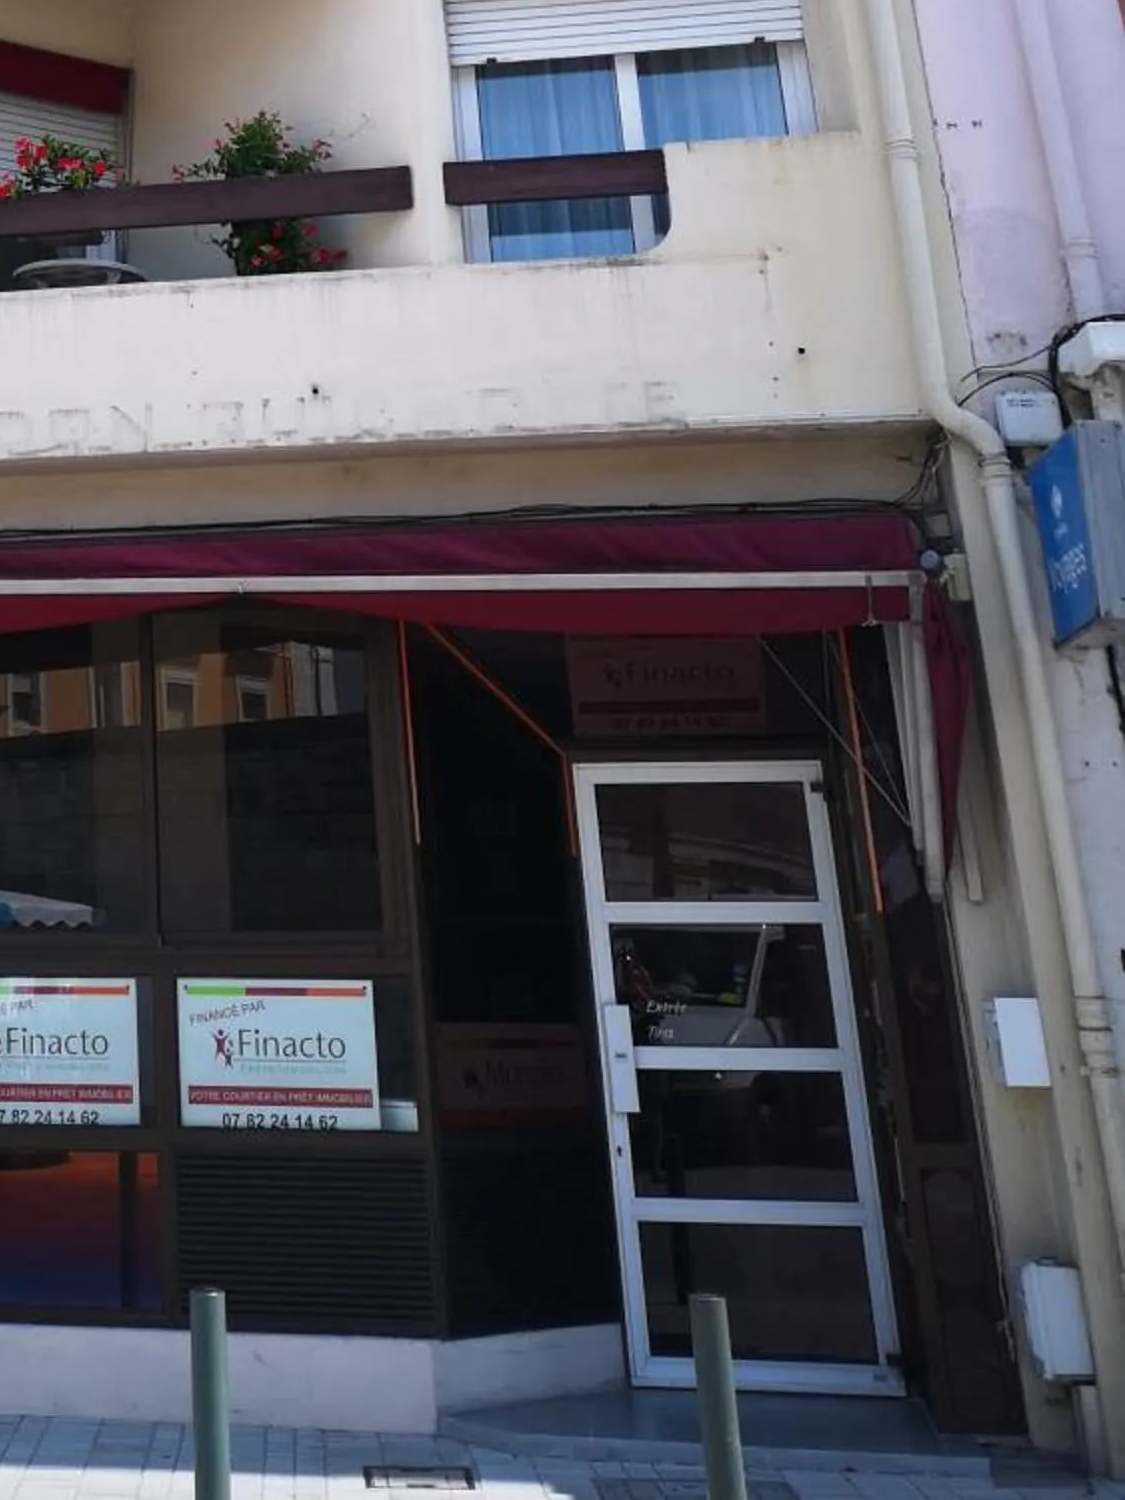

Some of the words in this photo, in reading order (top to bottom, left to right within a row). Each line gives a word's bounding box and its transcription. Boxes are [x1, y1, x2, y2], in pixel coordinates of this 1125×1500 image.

[6, 1026, 109, 1056] Finacto
[237, 1028, 347, 1059] Finacto
[10, 1109, 29, 1124] 82
[33, 1109, 53, 1124] 24
[57, 1109, 76, 1124] 14
[79, 1109, 100, 1124] 62
[221, 1113, 241, 1130] 07
[269, 1114, 291, 1131] 24
[295, 1114, 313, 1131] 14
[318, 1114, 339, 1131] 62
